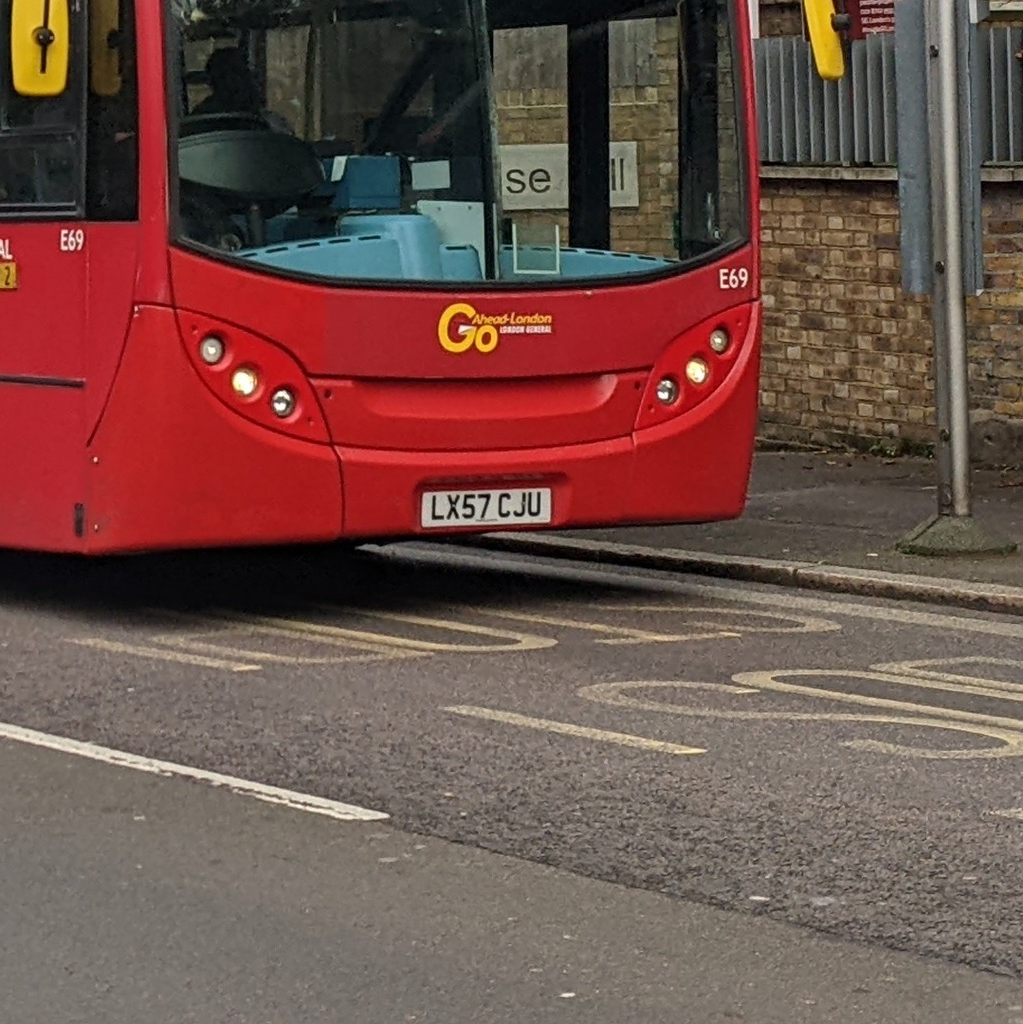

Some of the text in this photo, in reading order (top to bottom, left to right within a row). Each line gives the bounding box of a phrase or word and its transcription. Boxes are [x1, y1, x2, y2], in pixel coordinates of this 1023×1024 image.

[60, 229, 85, 252] E69
[719, 268, 749, 290] E69
[438, 303, 498, 353] Go
[431, 491, 542, 521] LX57 CJU
